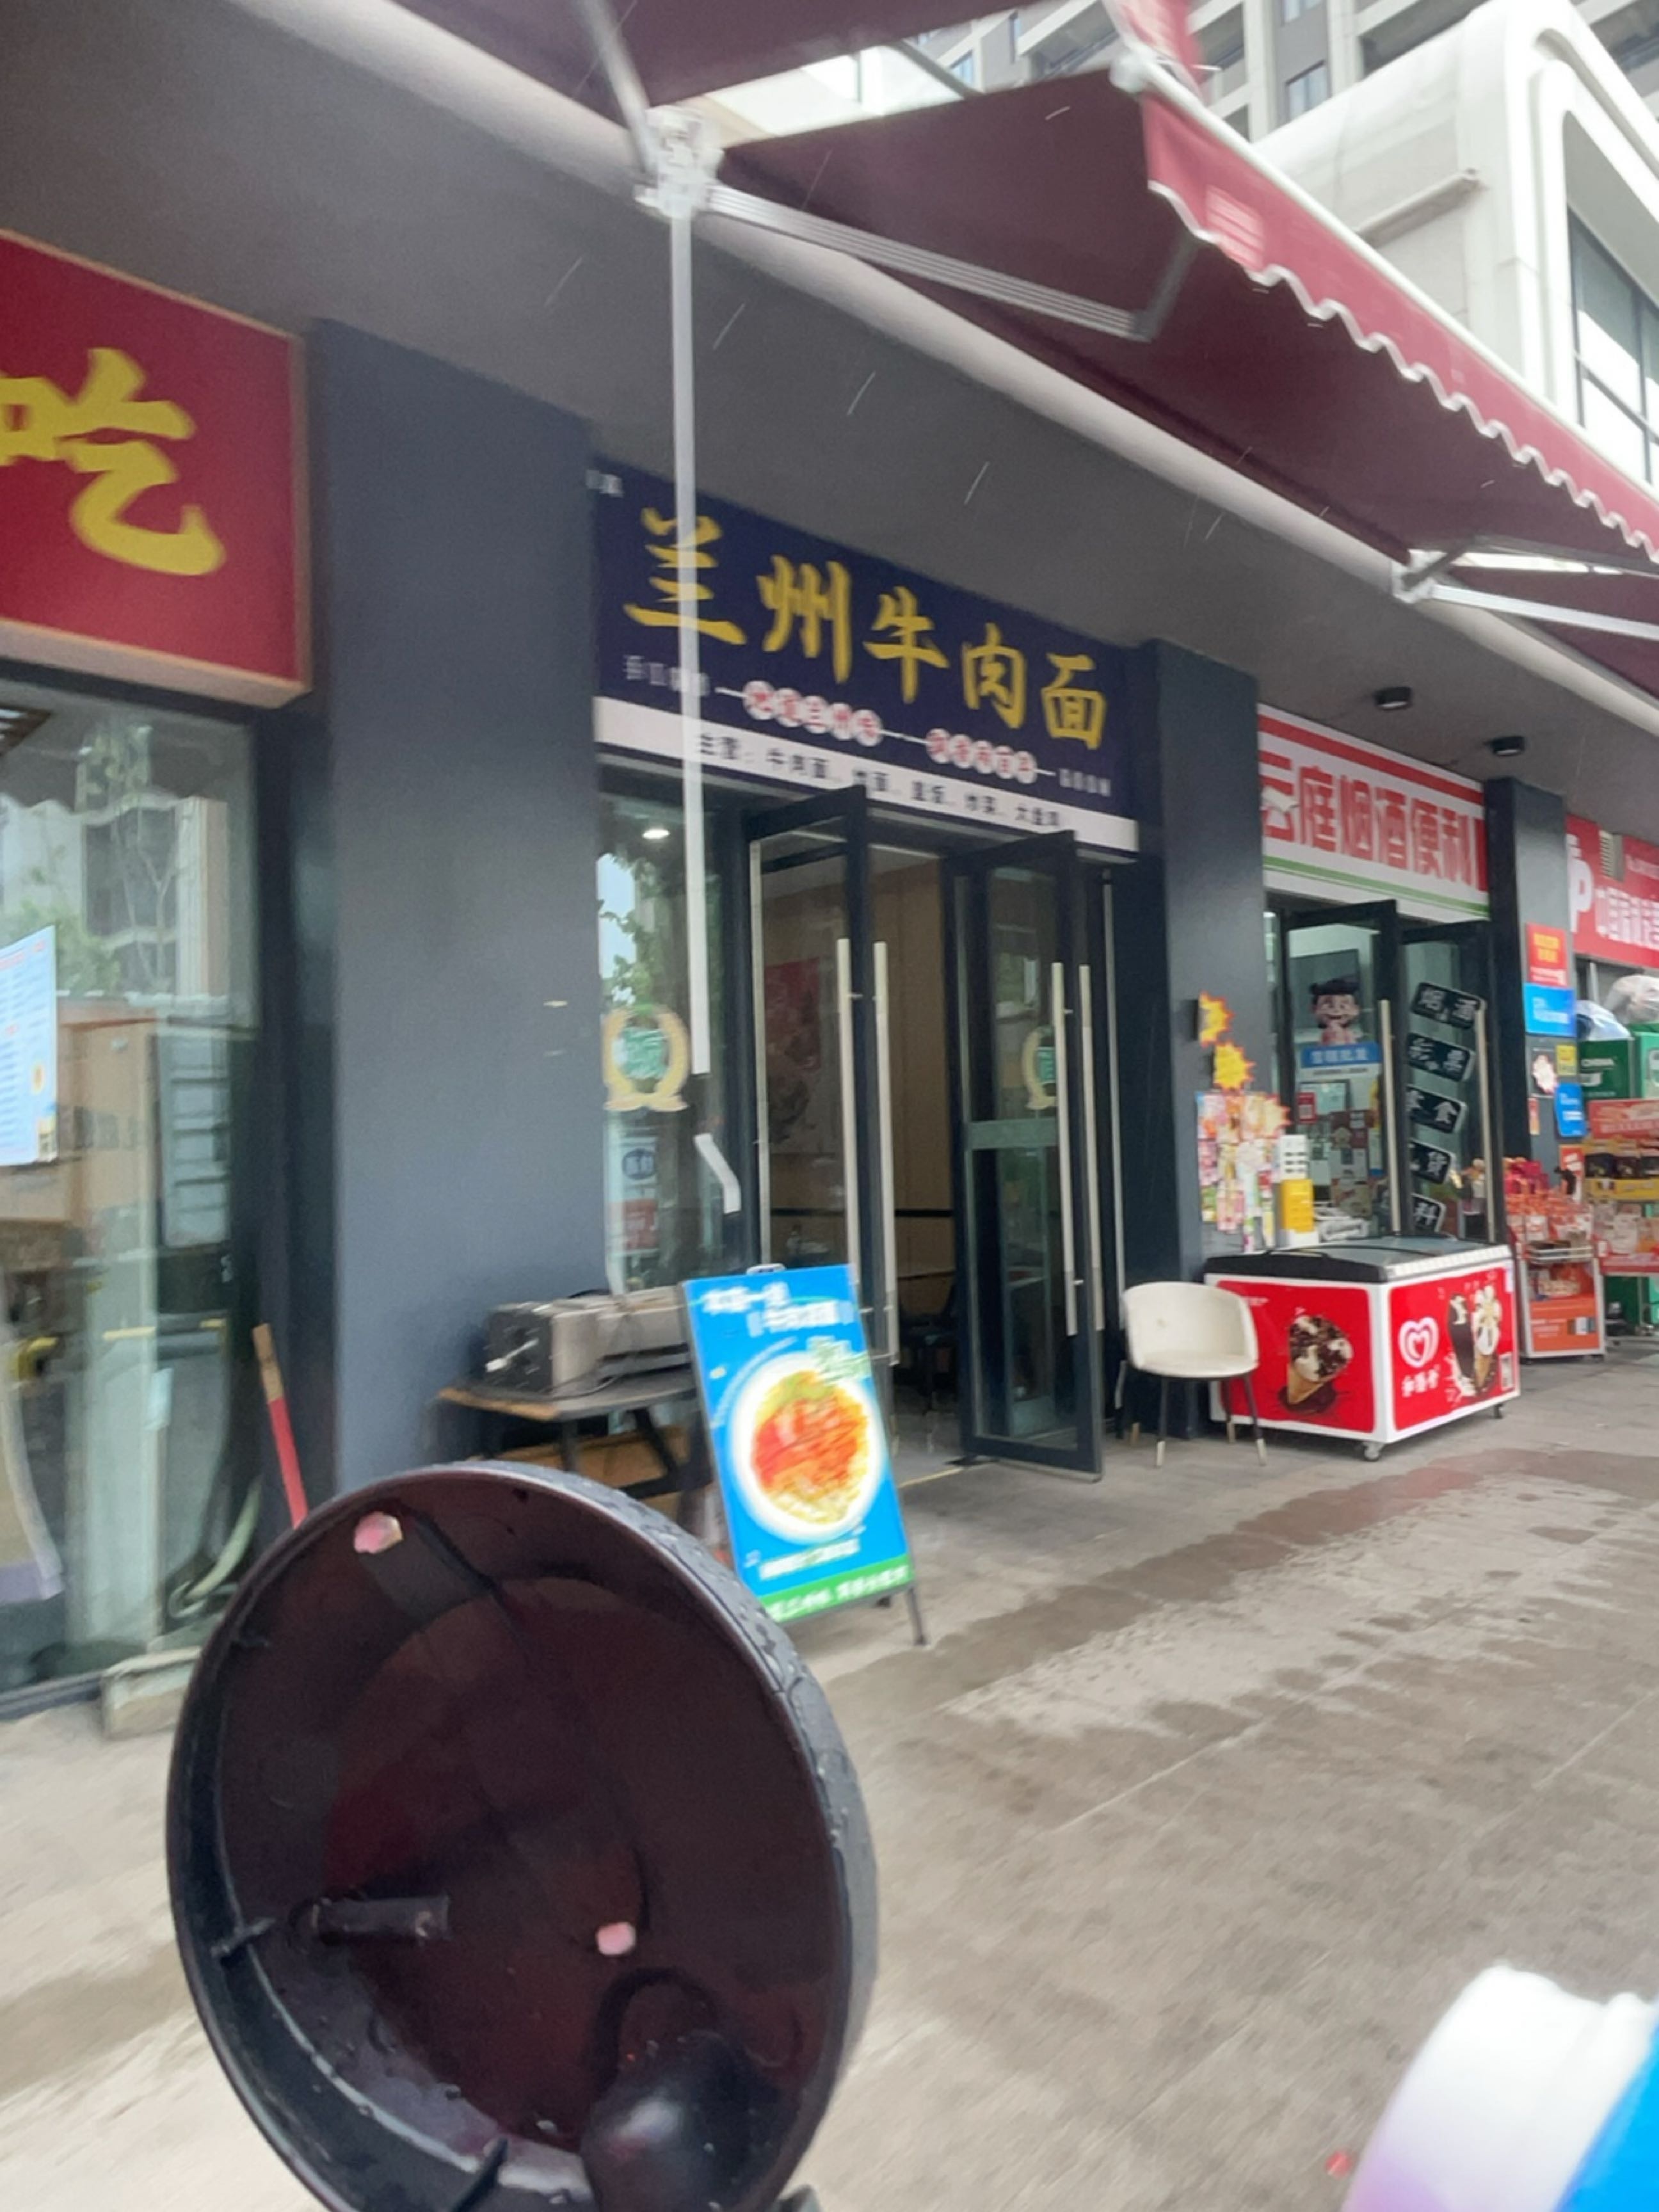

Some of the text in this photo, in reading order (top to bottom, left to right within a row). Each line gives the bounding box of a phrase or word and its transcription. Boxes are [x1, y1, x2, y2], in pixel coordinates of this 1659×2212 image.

[623, 508, 1106, 749] 兰州牛肉面
[1259, 750, 1486, 892] 云庭烟酒便利
